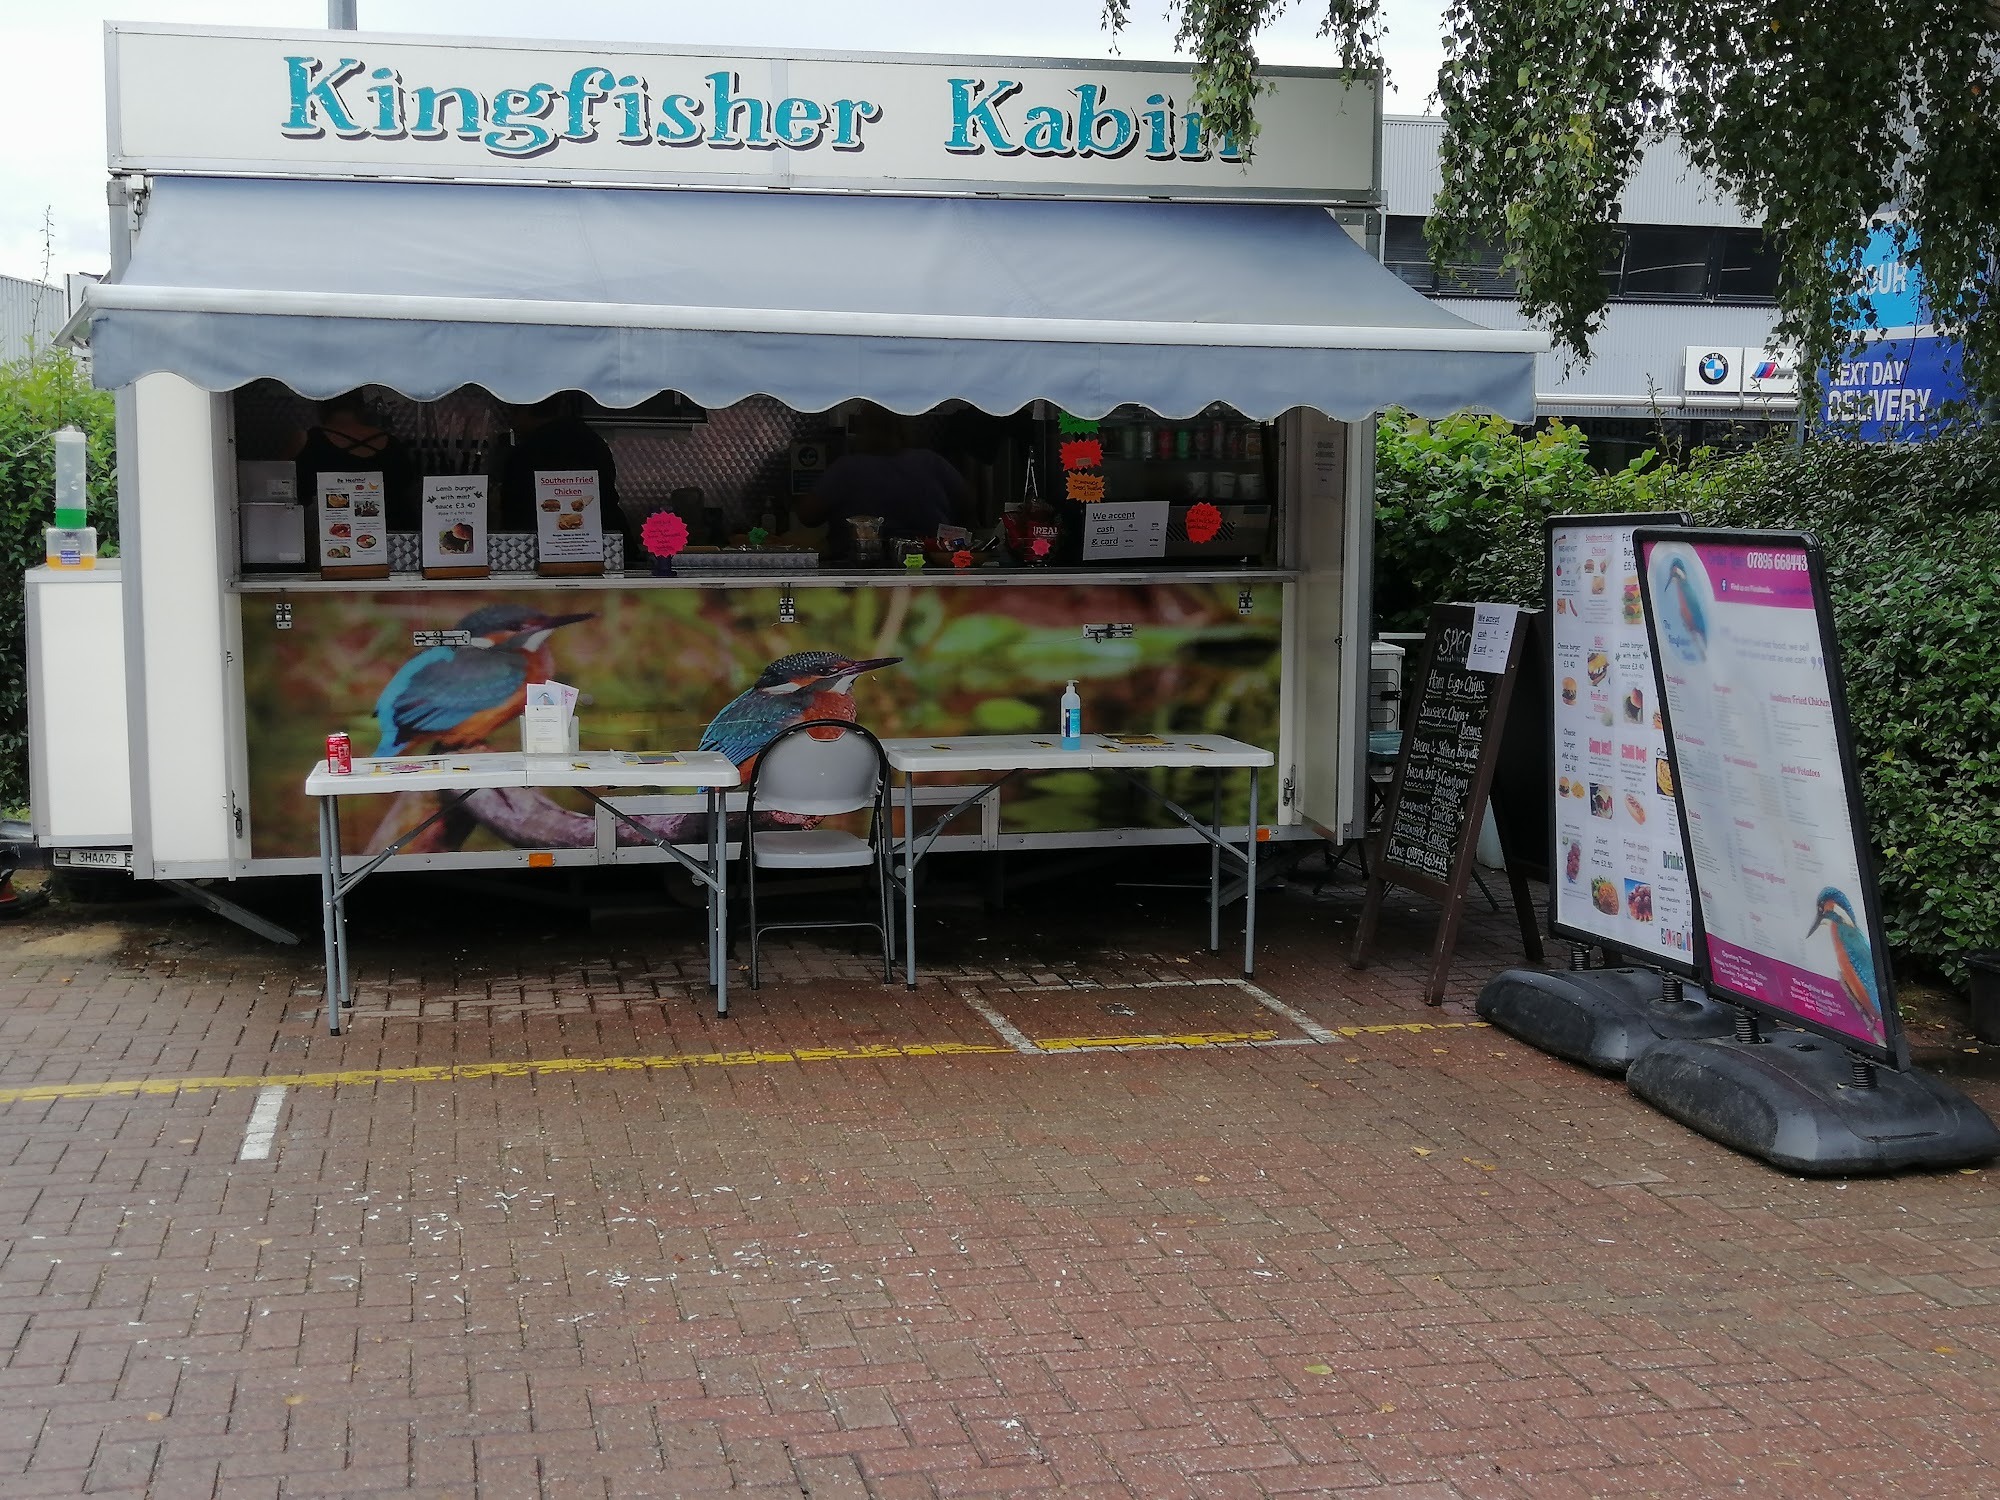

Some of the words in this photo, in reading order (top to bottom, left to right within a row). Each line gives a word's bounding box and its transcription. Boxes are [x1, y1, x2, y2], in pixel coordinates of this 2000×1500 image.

[281, 56, 883, 157] Kingfisher
[1872, 360, 1904, 386] DAY
[1827, 389, 1931, 421] DELIVERY
[540, 476, 574, 484] Southern
[454, 485, 477, 493] burger
[1092, 512, 1107, 520] We
[1108, 511, 1136, 520] accept
[1096, 525, 1115, 533] cash
[1100, 537, 1119, 545] card
[1585, 534, 1602, 542] Southern
[1622, 533, 1631, 542] Fat
[1592, 547, 1606, 555] Chicken
[1746, 552, 1774, 569] 07895
[1774, 553, 1809, 571] 668443
[1569, 644, 1581, 652] burger
[1630, 642, 1644, 650] burger
[1792, 694, 1808, 706] Fried
[1808, 695, 1830, 708] Chicken
[1564, 728, 1576, 737] Cheese
[1780, 763, 1796, 775] Jacket
[1797, 765, 1820, 778] Potatoes
[1624, 838, 1636, 848] Fresh
[1662, 850, 1684, 871] Drinks
